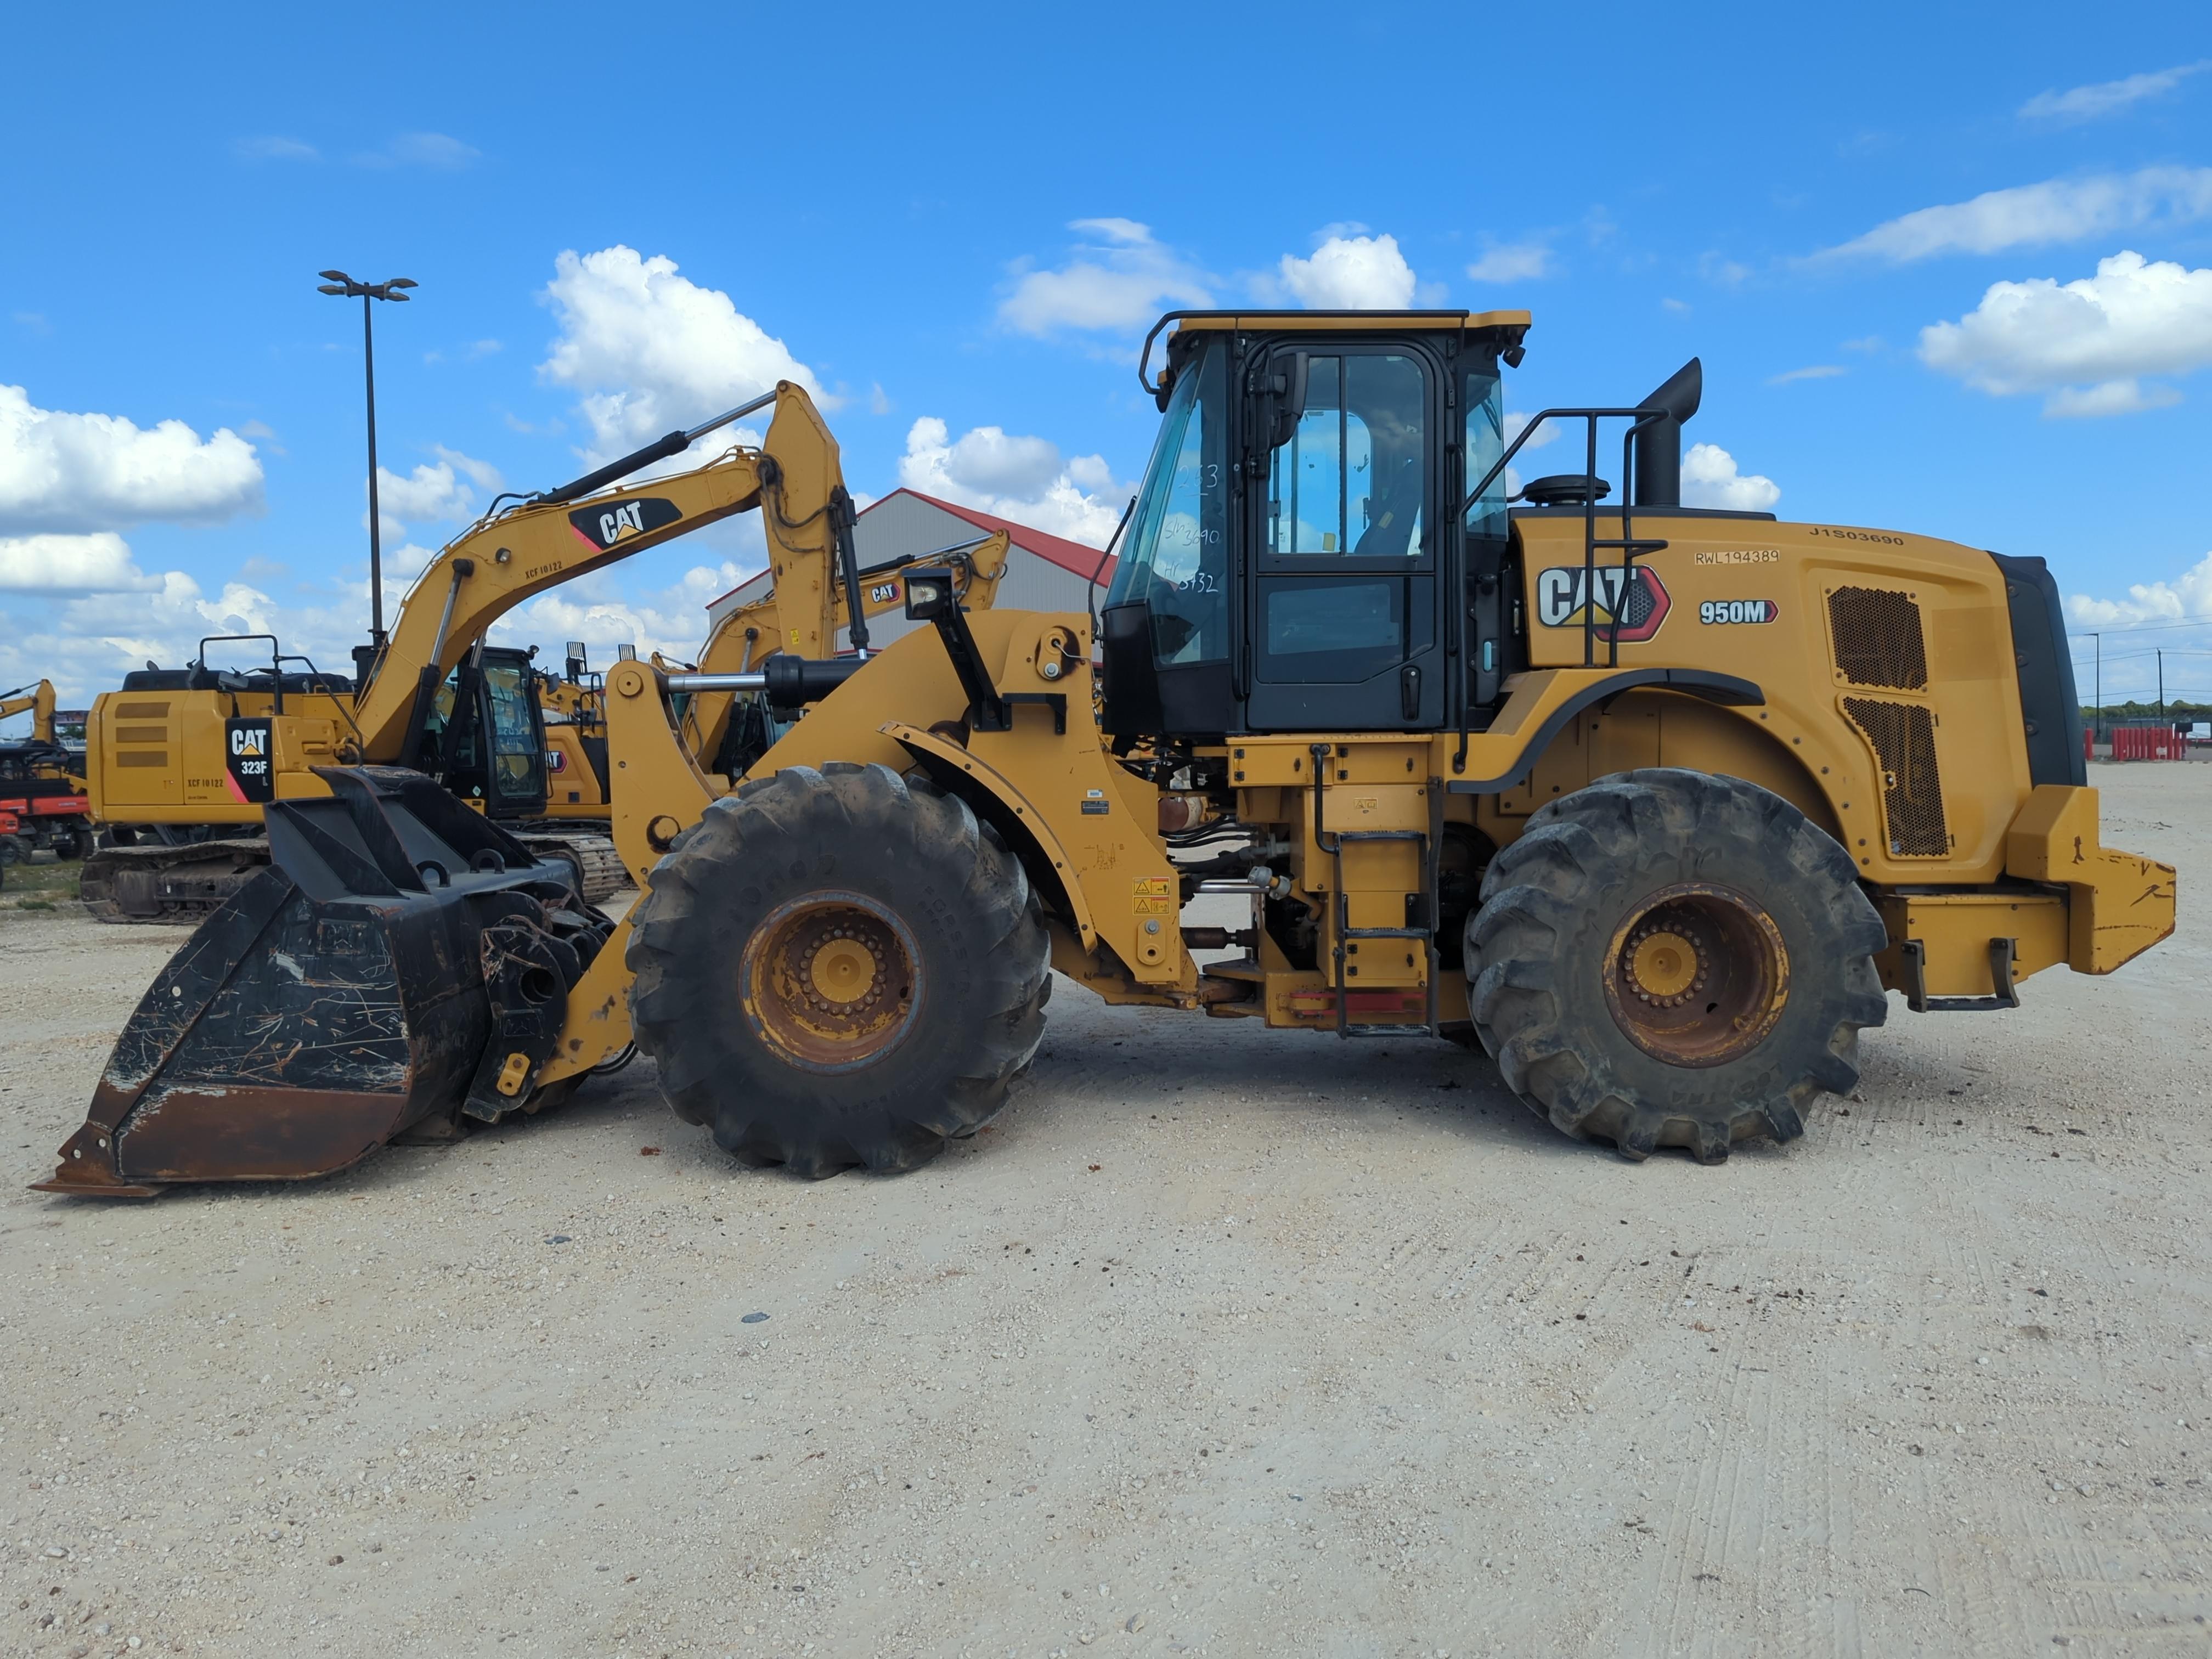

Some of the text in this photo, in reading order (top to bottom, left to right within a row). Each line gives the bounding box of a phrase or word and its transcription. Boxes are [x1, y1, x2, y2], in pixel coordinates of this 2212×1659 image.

[1178, 464, 1218, 487] 263
[600, 501, 644, 544] CAT
[1182, 529, 1220, 546] 3690
[1809, 528, 1904, 545] J1S03690
[1696, 550, 1779, 564] RWL194389
[872, 584, 893, 602] CAT
[1539, 568, 1637, 625] CAT
[1701, 601, 1765, 623] 950M
[232, 730, 266, 755] CAT
[241, 761, 267, 774] 323F
[545, 752, 560, 768] AT
[263, 776, 268, 786] L
